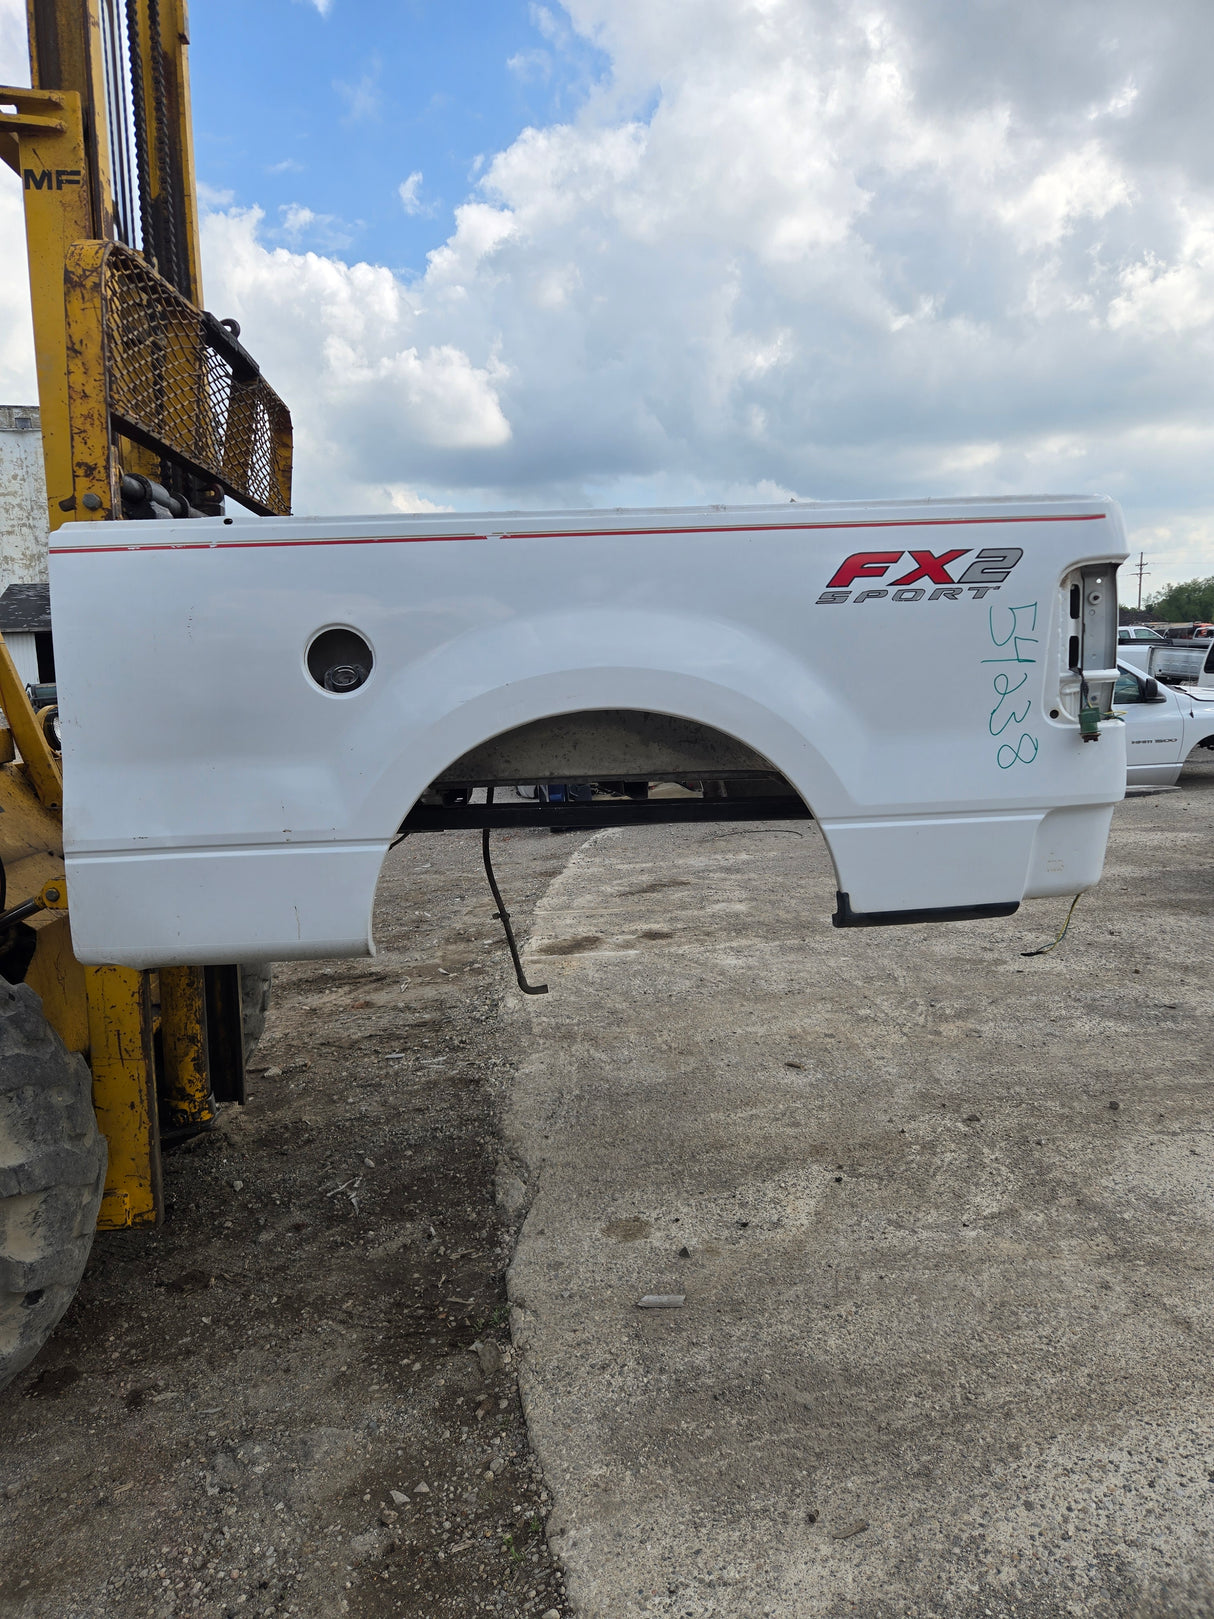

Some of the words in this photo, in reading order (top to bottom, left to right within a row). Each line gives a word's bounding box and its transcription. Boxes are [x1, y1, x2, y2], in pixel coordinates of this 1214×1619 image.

[23, 168, 82, 191] MF
[825, 547, 1024, 588] FX2
[815, 585, 1001, 605] SPORT
